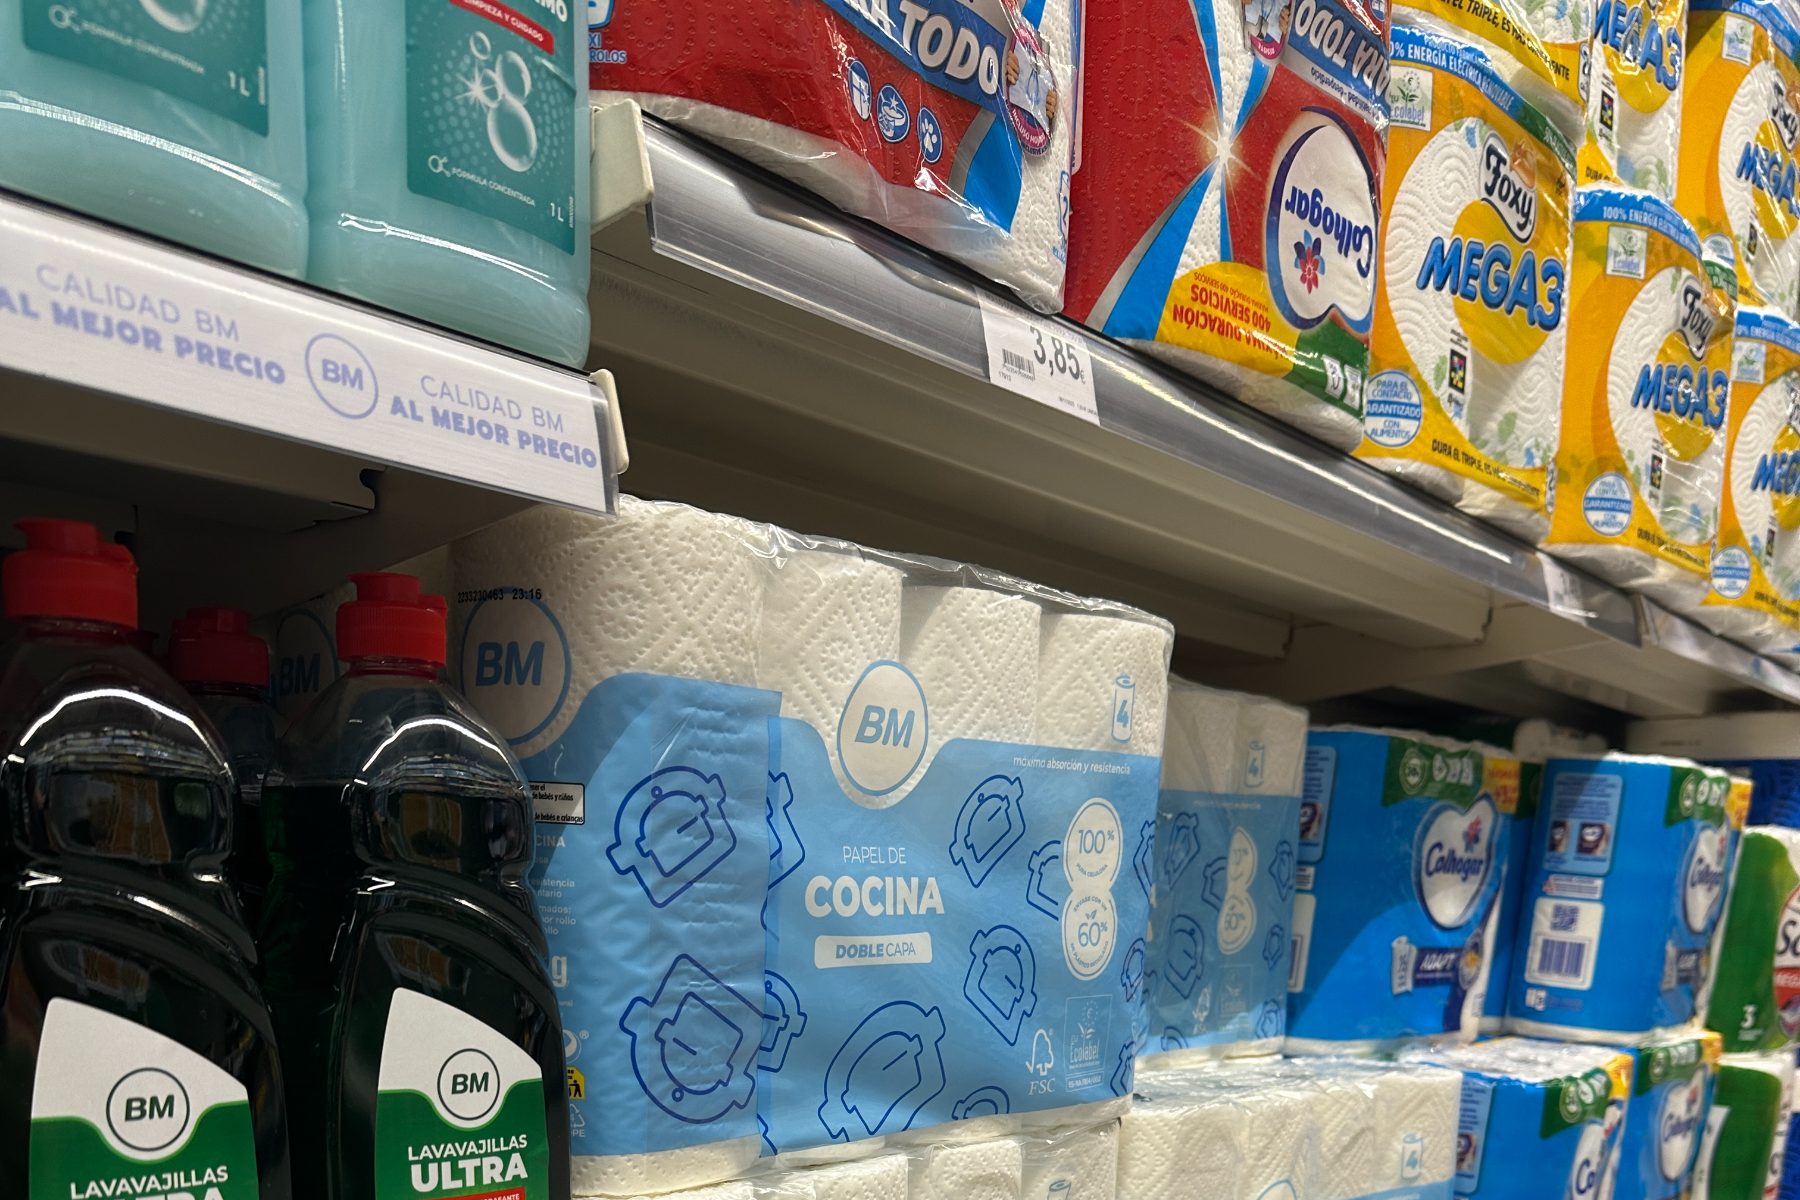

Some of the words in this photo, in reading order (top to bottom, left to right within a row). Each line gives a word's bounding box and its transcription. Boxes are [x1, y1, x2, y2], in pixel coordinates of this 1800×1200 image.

[1294, 0, 1356, 69] TODO
[1466, 0, 1501, 29] TRIPLE,
[1501, 18, 1512, 34] ES
[898, 2, 1000, 95] TODO
[1352, 40, 1392, 98] ARA
[1407, 43, 1447, 68] ENERGÍA
[1484, 143, 1534, 232] Foxy
[1284, 185, 1374, 279] Colhogar
[1602, 205, 1628, 221] 100%
[36, 263, 181, 325] CALIDAD
[194, 308, 240, 342] BM
[1415, 235, 1564, 332] MEGA3
[1172, 303, 1242, 341] DURACIÓN
[1190, 284, 1251, 325] SERVICIOS
[1250, 310, 1272, 333] 400
[50, 300, 163, 354] MEJOR
[173, 333, 287, 386] PRECIO
[320, 356, 365, 392] BM
[420, 374, 523, 421] CALIDAD
[531, 405, 565, 434] BM
[1365, 403, 1422, 418] ARANTIZADO
[1630, 363, 1730, 431] MEGA3
[390, 394, 424, 424] AL
[431, 404, 510, 446] MEJOR
[516, 428, 598, 470] PRECIO
[1383, 419, 1401, 429] CON
[1431, 439, 1453, 458] DURA
[474, 639, 546, 688] BM
[854, 704, 916, 749] BM
[1115, 701, 1131, 730] 4
[842, 845, 885, 864] PAPEL
[887, 846, 907, 865] DE
[1424, 840, 1484, 883] Colhogar
[803, 874, 945, 918] COCINA
[834, 943, 885, 960] DOBLE
[885, 941, 917, 958] CAPA
[450, 1070, 491, 1096] BM
[1028, 1078, 1056, 1096] FSC
[123, 1093, 176, 1123] BM
[407, 1133, 528, 1163] LAVAVAJILLAS
[409, 1151, 530, 1194] ULTRA
